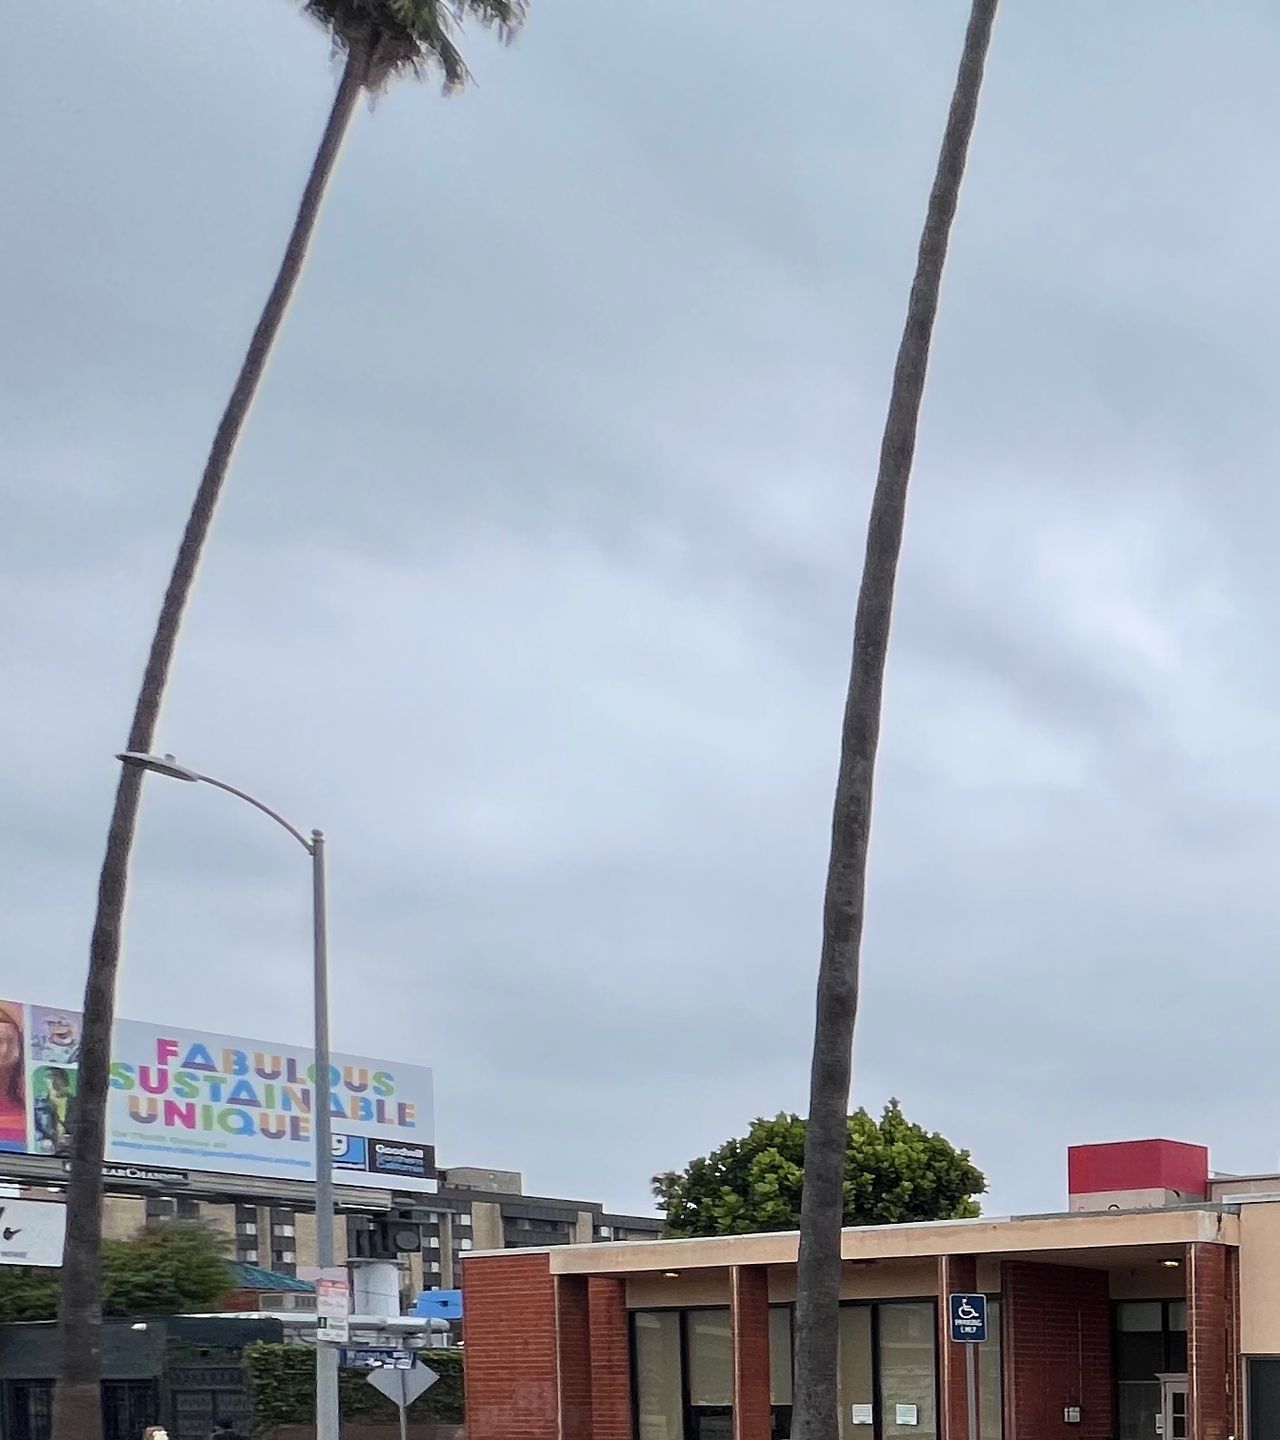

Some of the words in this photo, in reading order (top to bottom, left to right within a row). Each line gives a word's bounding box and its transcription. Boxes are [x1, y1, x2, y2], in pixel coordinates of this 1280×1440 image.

[109, 1061, 416, 1129] SUSTAINABLE
[156, 1037, 395, 1097] FABULOUS
[127, 1094, 311, 1143] UNIQUE
